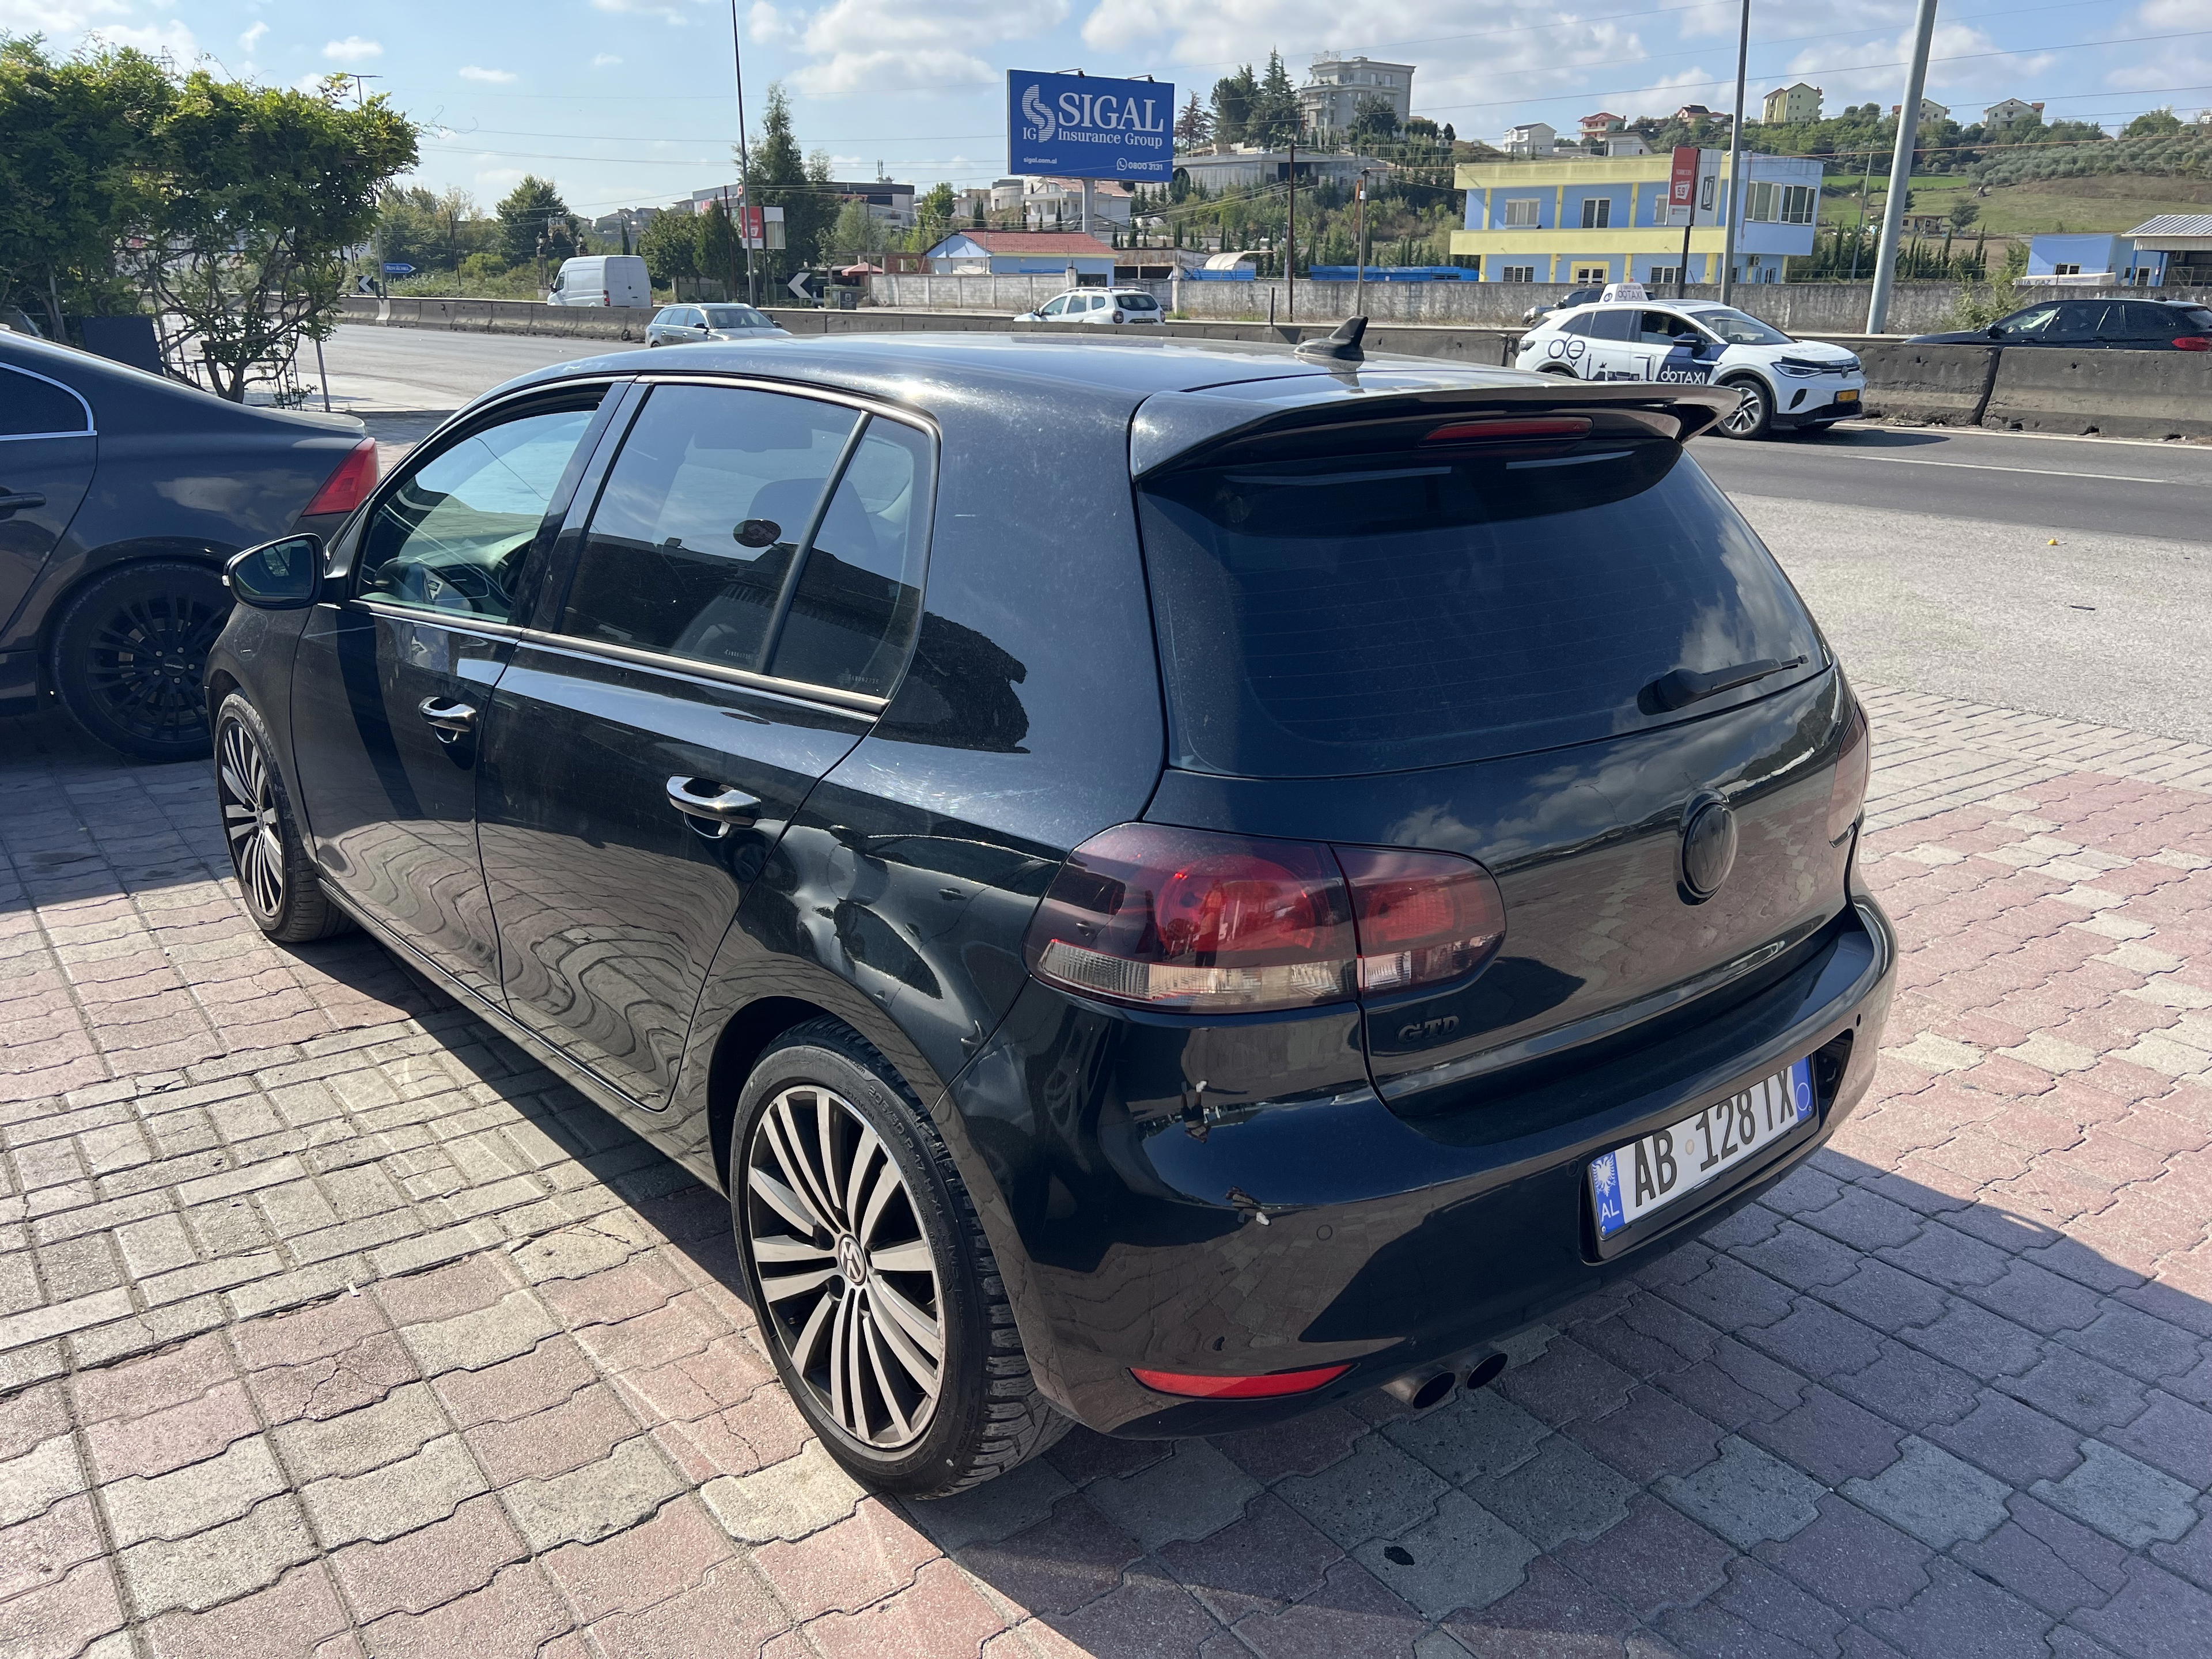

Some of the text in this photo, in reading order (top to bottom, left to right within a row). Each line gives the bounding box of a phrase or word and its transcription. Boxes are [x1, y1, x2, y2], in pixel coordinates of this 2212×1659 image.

[1058, 92, 1164, 132] SIGAL
[1023, 127, 1036, 140] IG
[1058, 128, 1163, 149] Insurance Group
[1128, 162, 1163, 171] 0800 3131
[1660, 365, 1706, 384] doTAXI
[1397, 1016, 1460, 1042] GTD
[1634, 1130, 1677, 1207] AB
[1695, 1088, 1756, 1172] 128
[1600, 1199, 1620, 1222] AL
